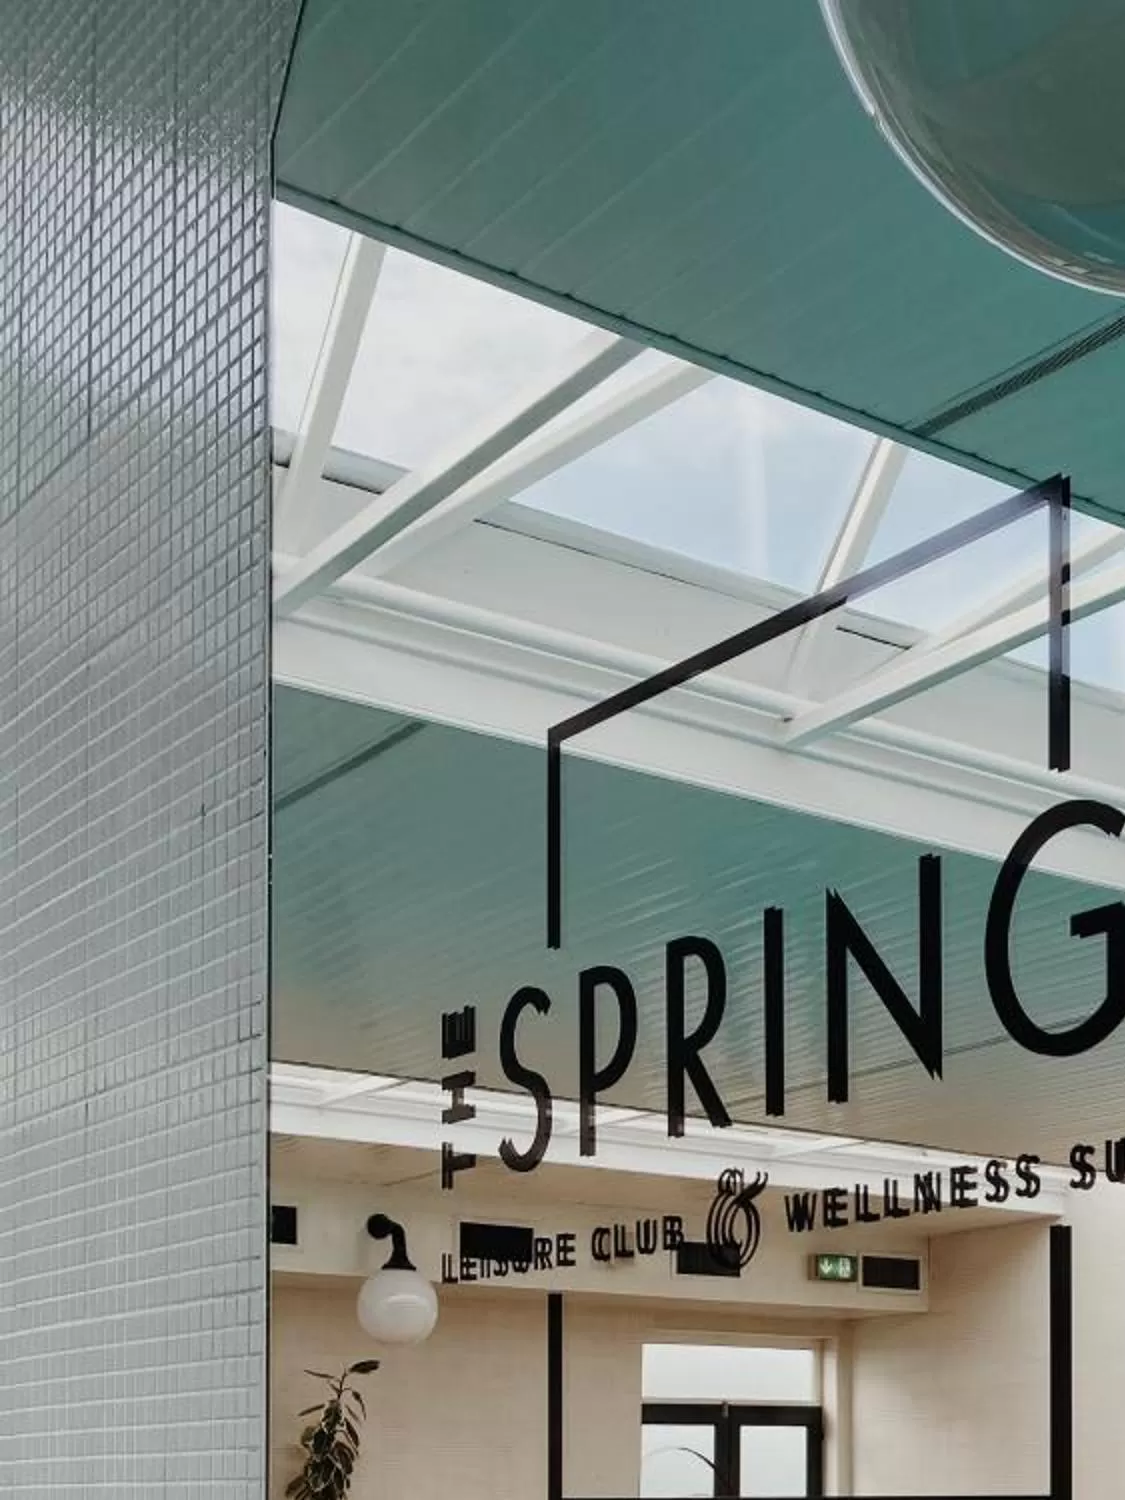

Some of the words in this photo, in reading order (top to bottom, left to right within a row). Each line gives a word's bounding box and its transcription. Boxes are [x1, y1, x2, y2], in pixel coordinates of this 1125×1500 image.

[440, 1005, 477, 1190] THE
[591, 1214, 685, 1262] CLUB
[784, 1153, 1042, 1233] WELLNESS
